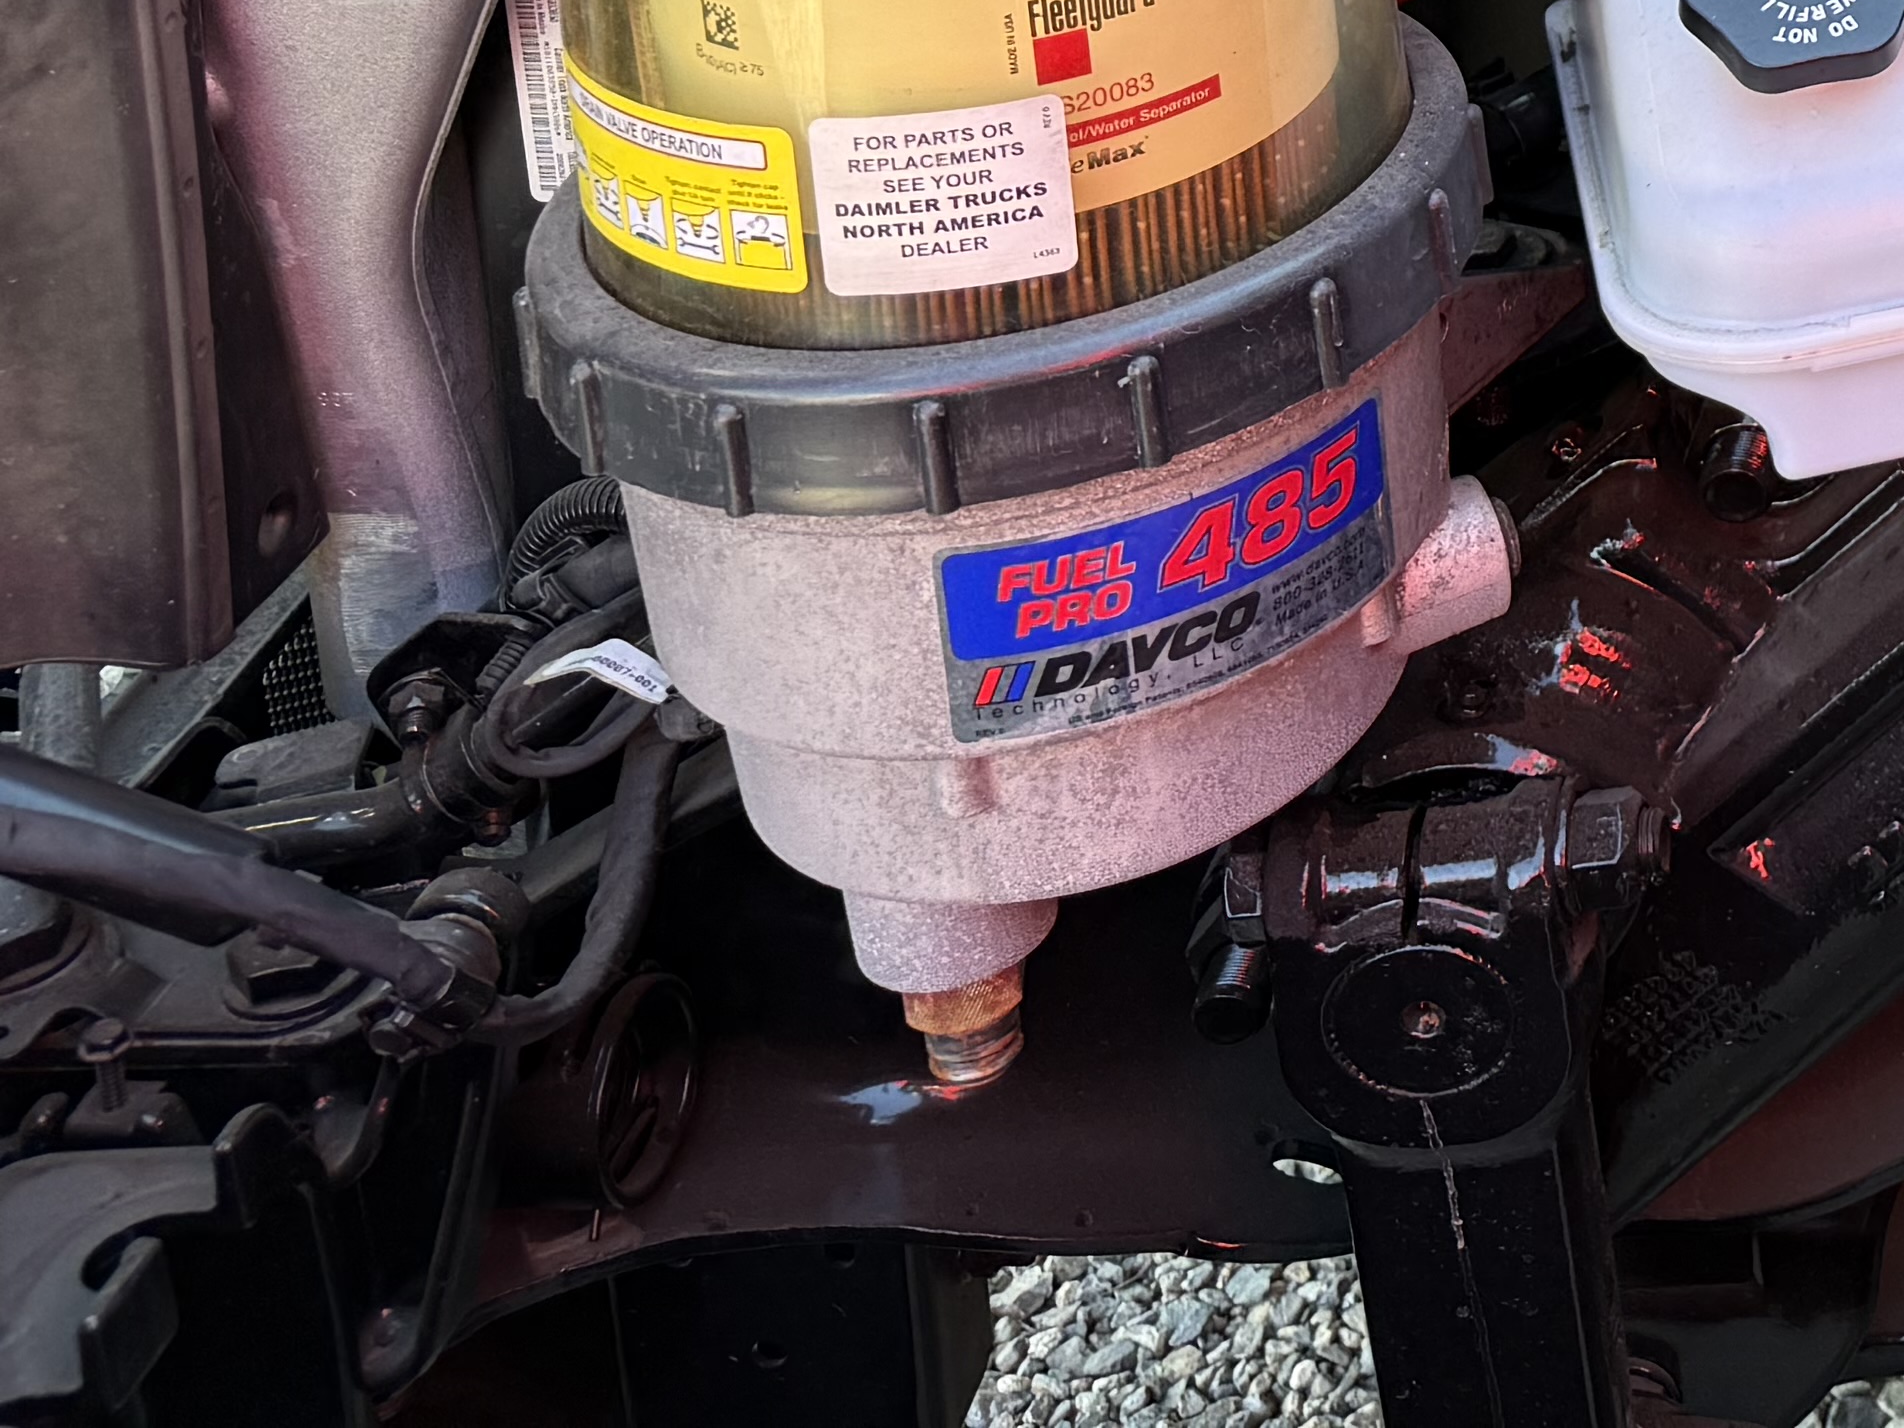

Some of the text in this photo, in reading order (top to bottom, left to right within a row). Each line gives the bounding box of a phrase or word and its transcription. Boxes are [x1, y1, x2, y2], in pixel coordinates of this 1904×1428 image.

[1004, 13, 1015, 33] USA
[1772, 14, 1859, 44] DO NOT
[1064, 72, 1155, 116] S20083
[1139, 86, 1211, 122] Separator
[604, 114, 723, 160] VALVE OPERATION
[853, 122, 1014, 152] FOR PARTS OR
[848, 142, 1025, 173] REPLACEMENTS
[883, 169, 994, 193] SEE YOUR
[835, 181, 1048, 218] DAIMLER TRUCKS
[842, 205, 1044, 239] NORTH AMERICA
[901, 236, 989, 258] DEALER
[995, 420, 1361, 604] FUEL 485
[1014, 579, 1133, 641] PRO
[1275, 588, 1327, 627] Made in
[1035, 590, 1262, 696] DAVCO
[973, 670, 1173, 721] Technology,
